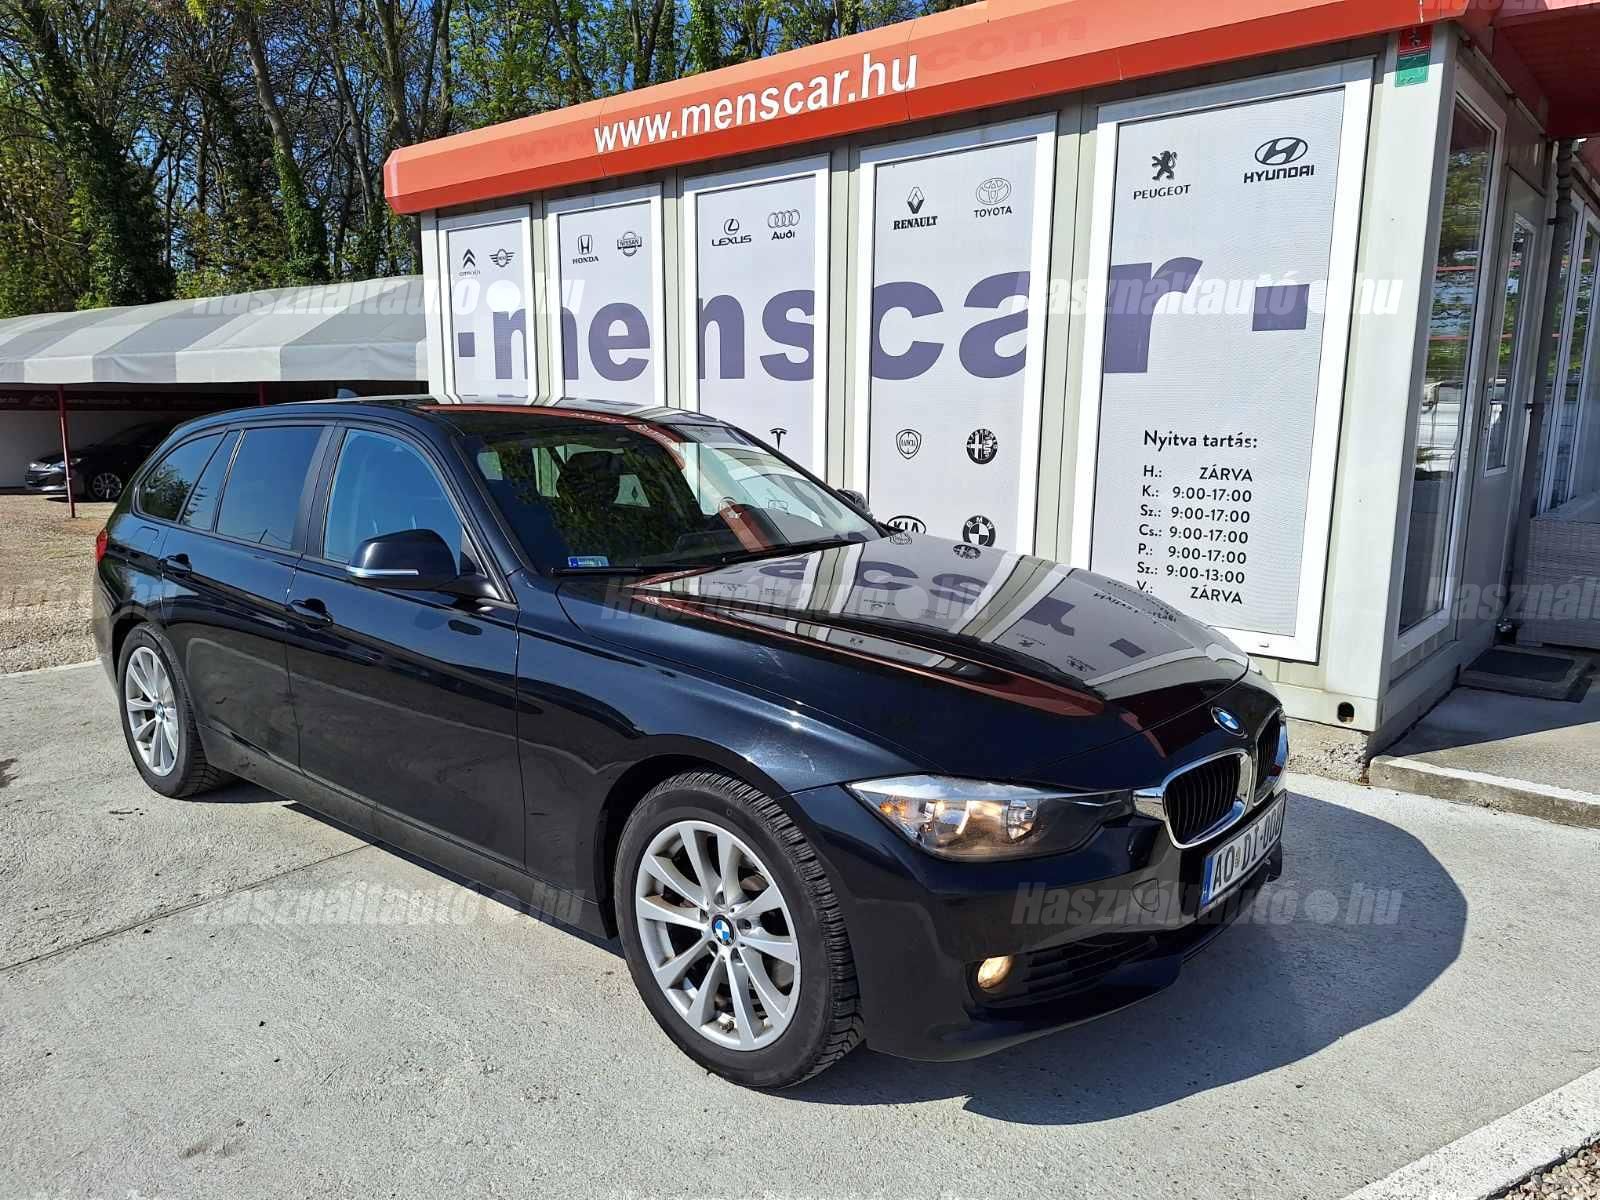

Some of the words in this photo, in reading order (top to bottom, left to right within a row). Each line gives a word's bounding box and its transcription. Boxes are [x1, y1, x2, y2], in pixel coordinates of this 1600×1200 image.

[594, 53, 918, 154] www.menscar.hu
[1243, 164, 1315, 184] HYUNDAI
[1133, 184, 1191, 200] PEUGEOT
[973, 206, 1013, 218] TOYOTA
[893, 215, 938, 230] RENAULT
[712, 234, 752, 247] LEXUS
[771, 230, 796, 241] Audi
[572, 256, 599, 265] HONDA
[1144, 430, 1197, 452] Nyitva
[1203, 432, 1258, 448] tartás:
[1143, 465, 1162, 478] H.:
[1200, 464, 1253, 482] ZÁRVA
[1142, 485, 1159, 498] K.:
[1172, 486, 1252, 503] 9:00-17:00
[1140, 504, 1161, 517] Sz.:
[1171, 506, 1250, 523] 9:00-17:00
[1138, 523, 1162, 537] Cs.:
[1169, 526, 1248, 544] 9:00-17:00
[1138, 543, 1153, 556] P.:
[1168, 546, 1247, 564] 9:00-17:00
[1137, 561, 1158, 575] Sz.:
[1166, 565, 1245, 584] 9:00-13:00
[1136, 580, 1153, 593] V.:
[1190, 584, 1242, 604] ZÁRVA
